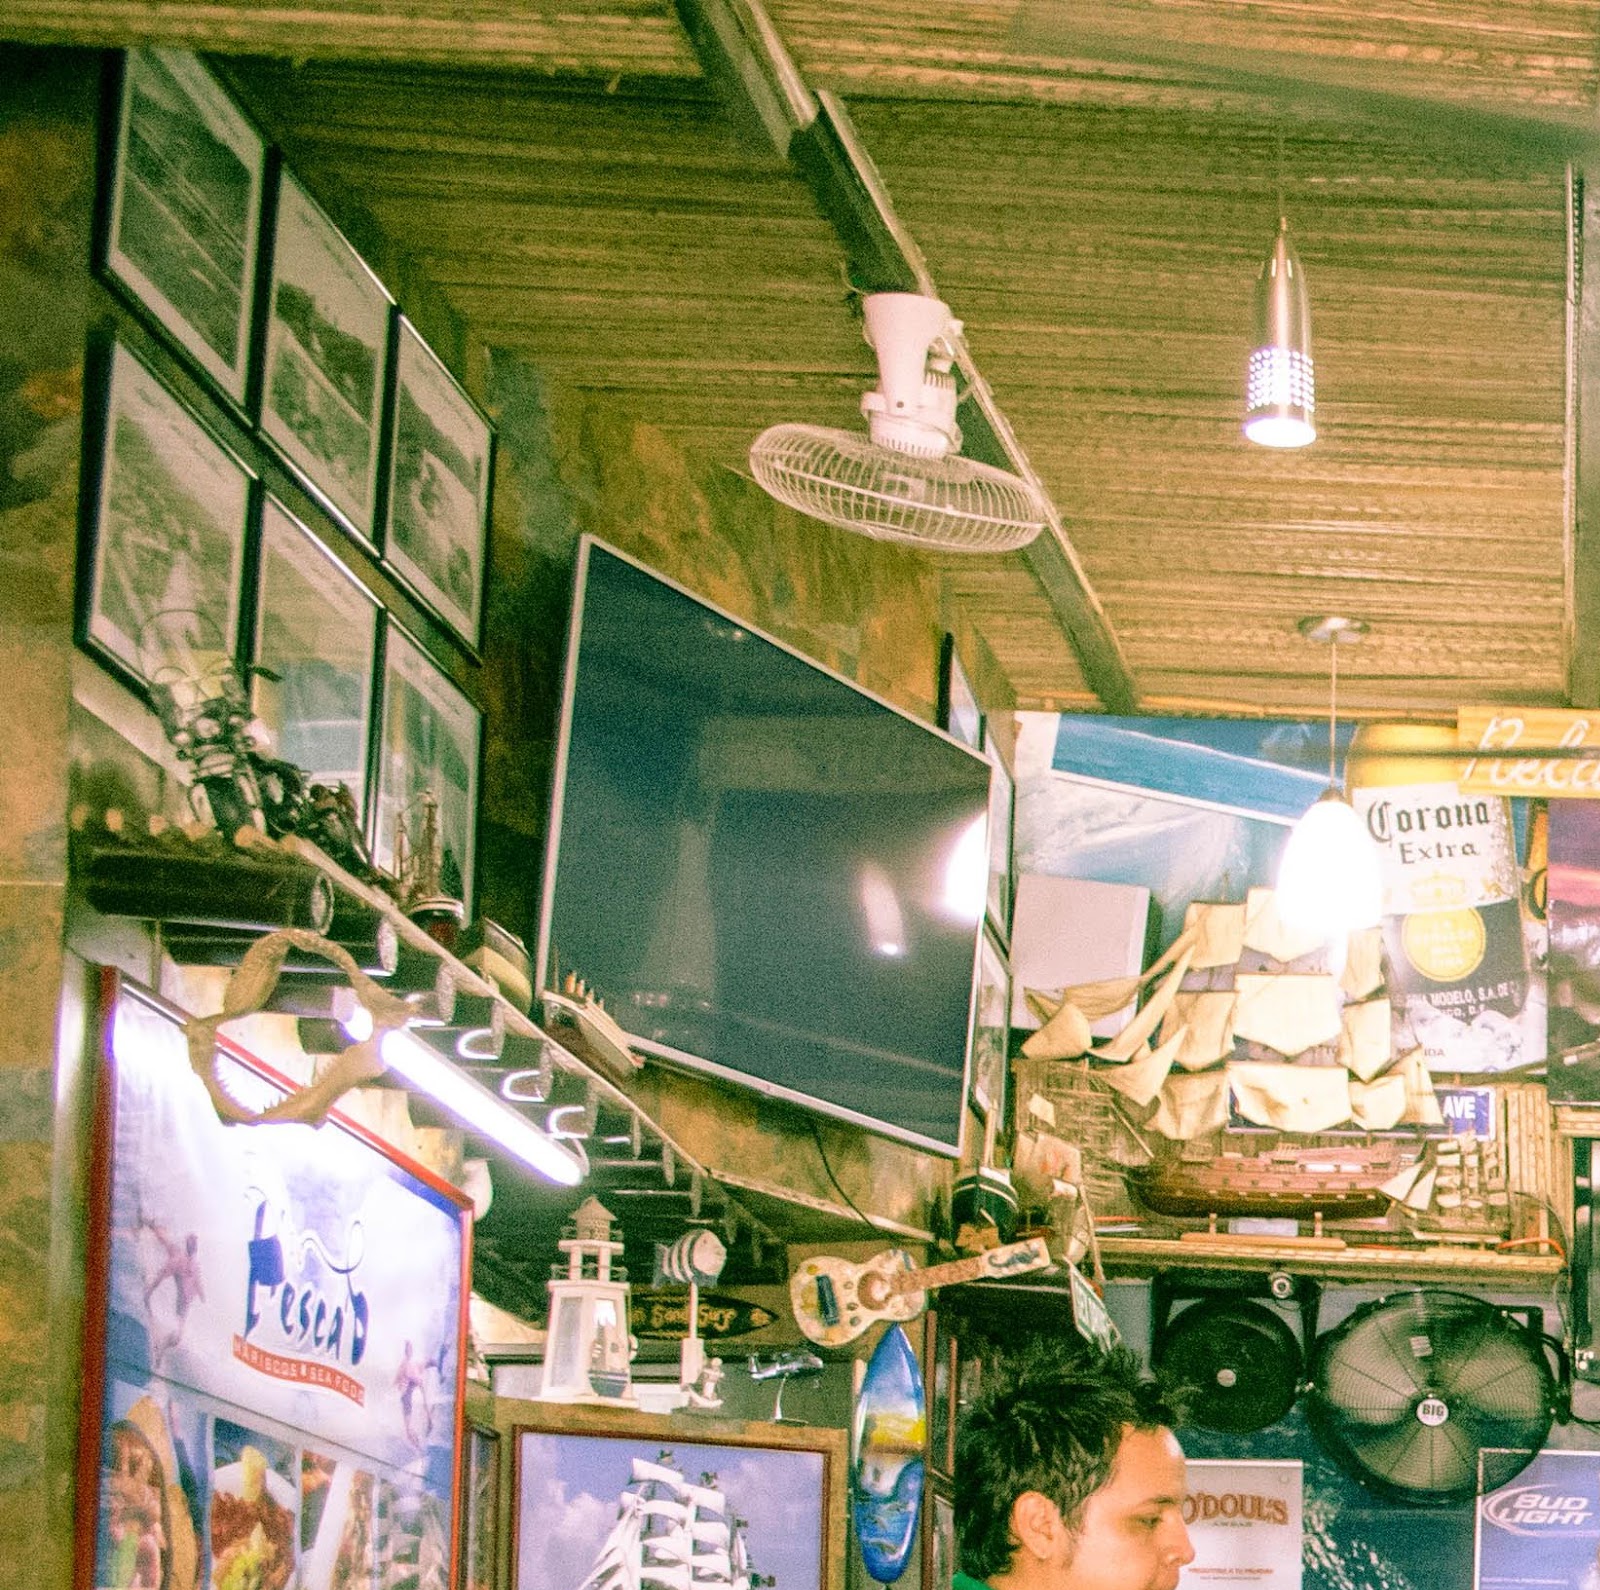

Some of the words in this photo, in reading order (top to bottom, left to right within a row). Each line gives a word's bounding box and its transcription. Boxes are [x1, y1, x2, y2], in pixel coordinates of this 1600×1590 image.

[1367, 800, 1490, 847] Corona
[1399, 842, 1480, 864] Extra
[1442, 1095, 1477, 1119] AVE
[1513, 1494, 1588, 1510] BUD
[1501, 1510, 1594, 1525] LIGHT
